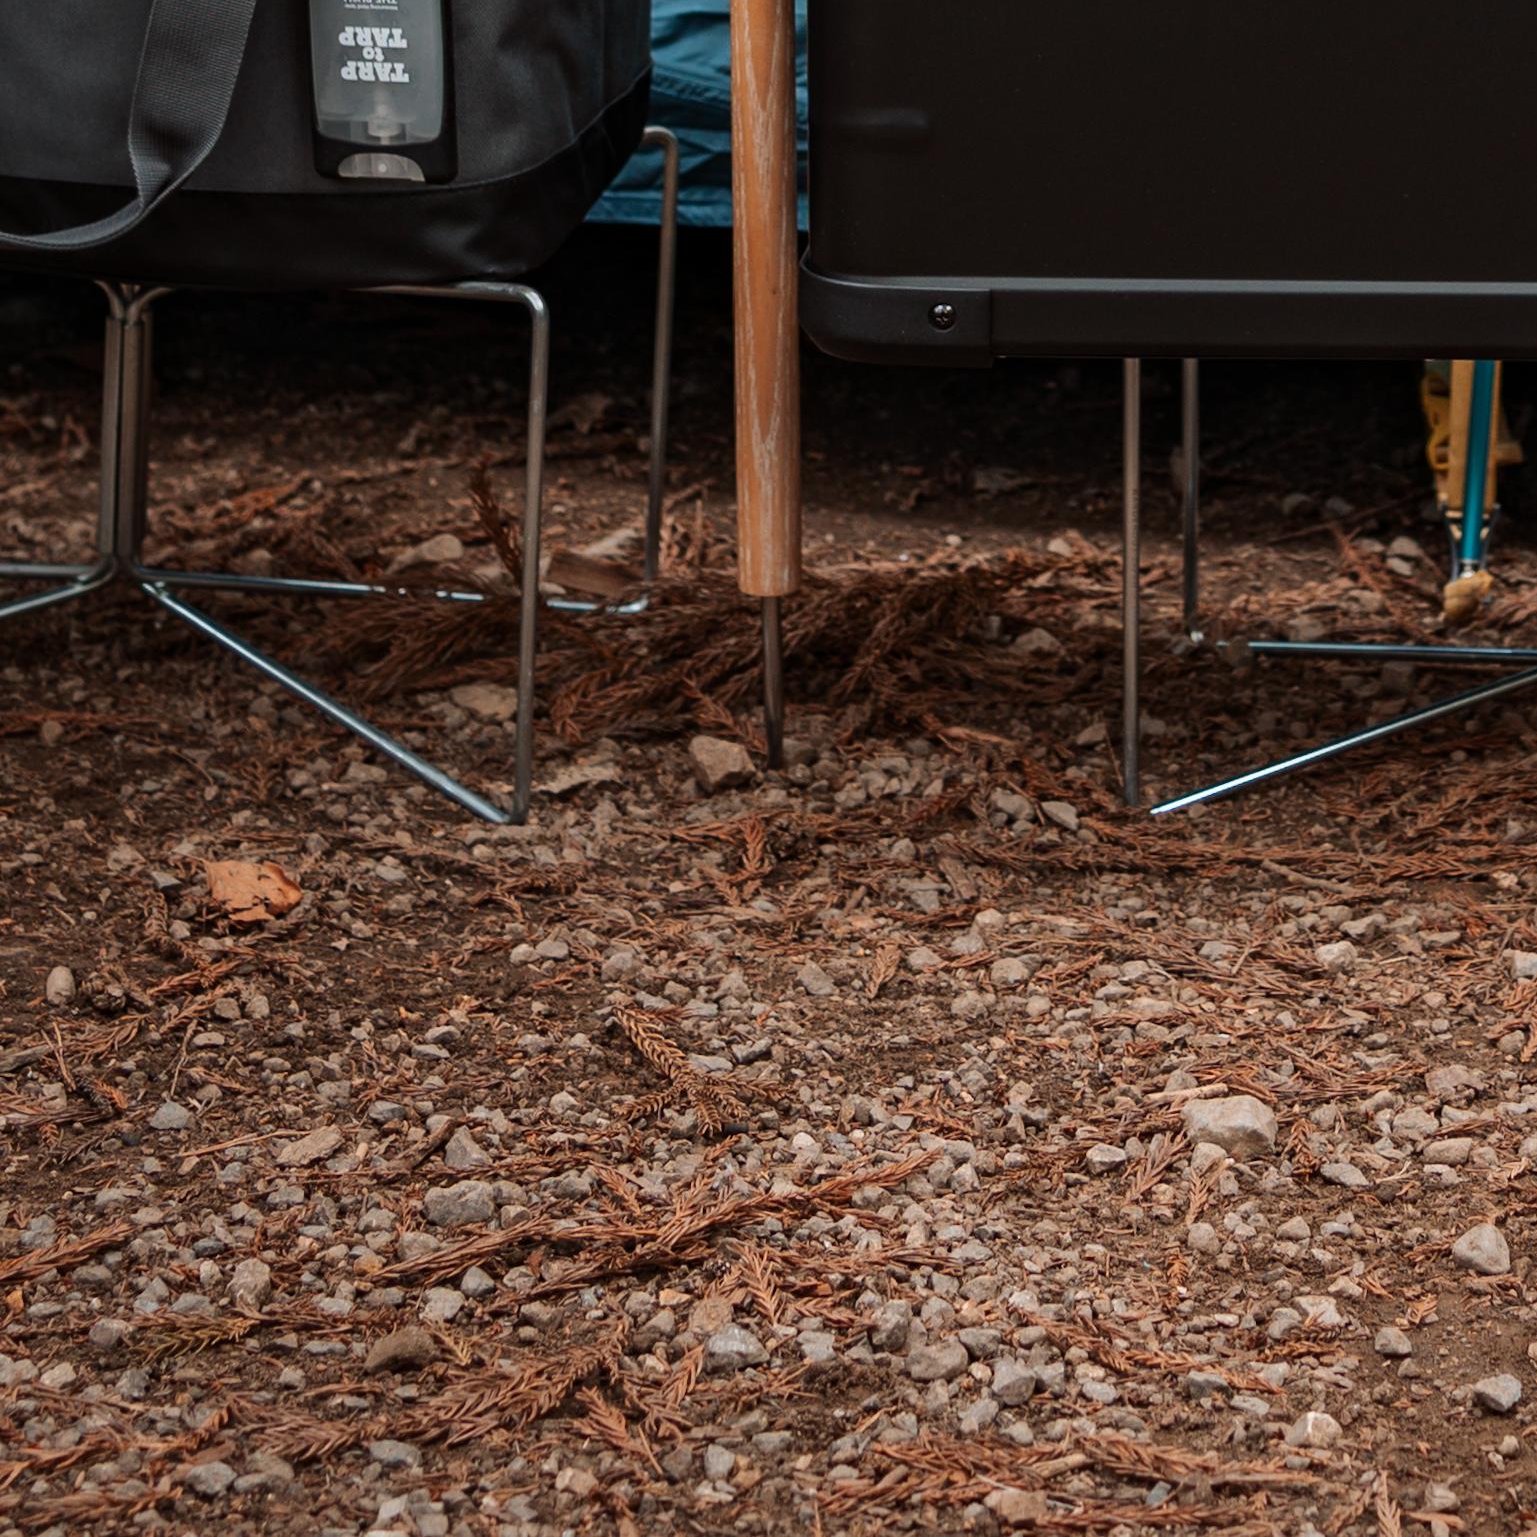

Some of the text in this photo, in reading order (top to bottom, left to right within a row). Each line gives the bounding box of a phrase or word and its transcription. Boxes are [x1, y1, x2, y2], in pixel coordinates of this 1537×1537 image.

[338, 26, 408, 48] TARP
[362, 46, 385, 62] to
[340, 60, 410, 83] TARP
